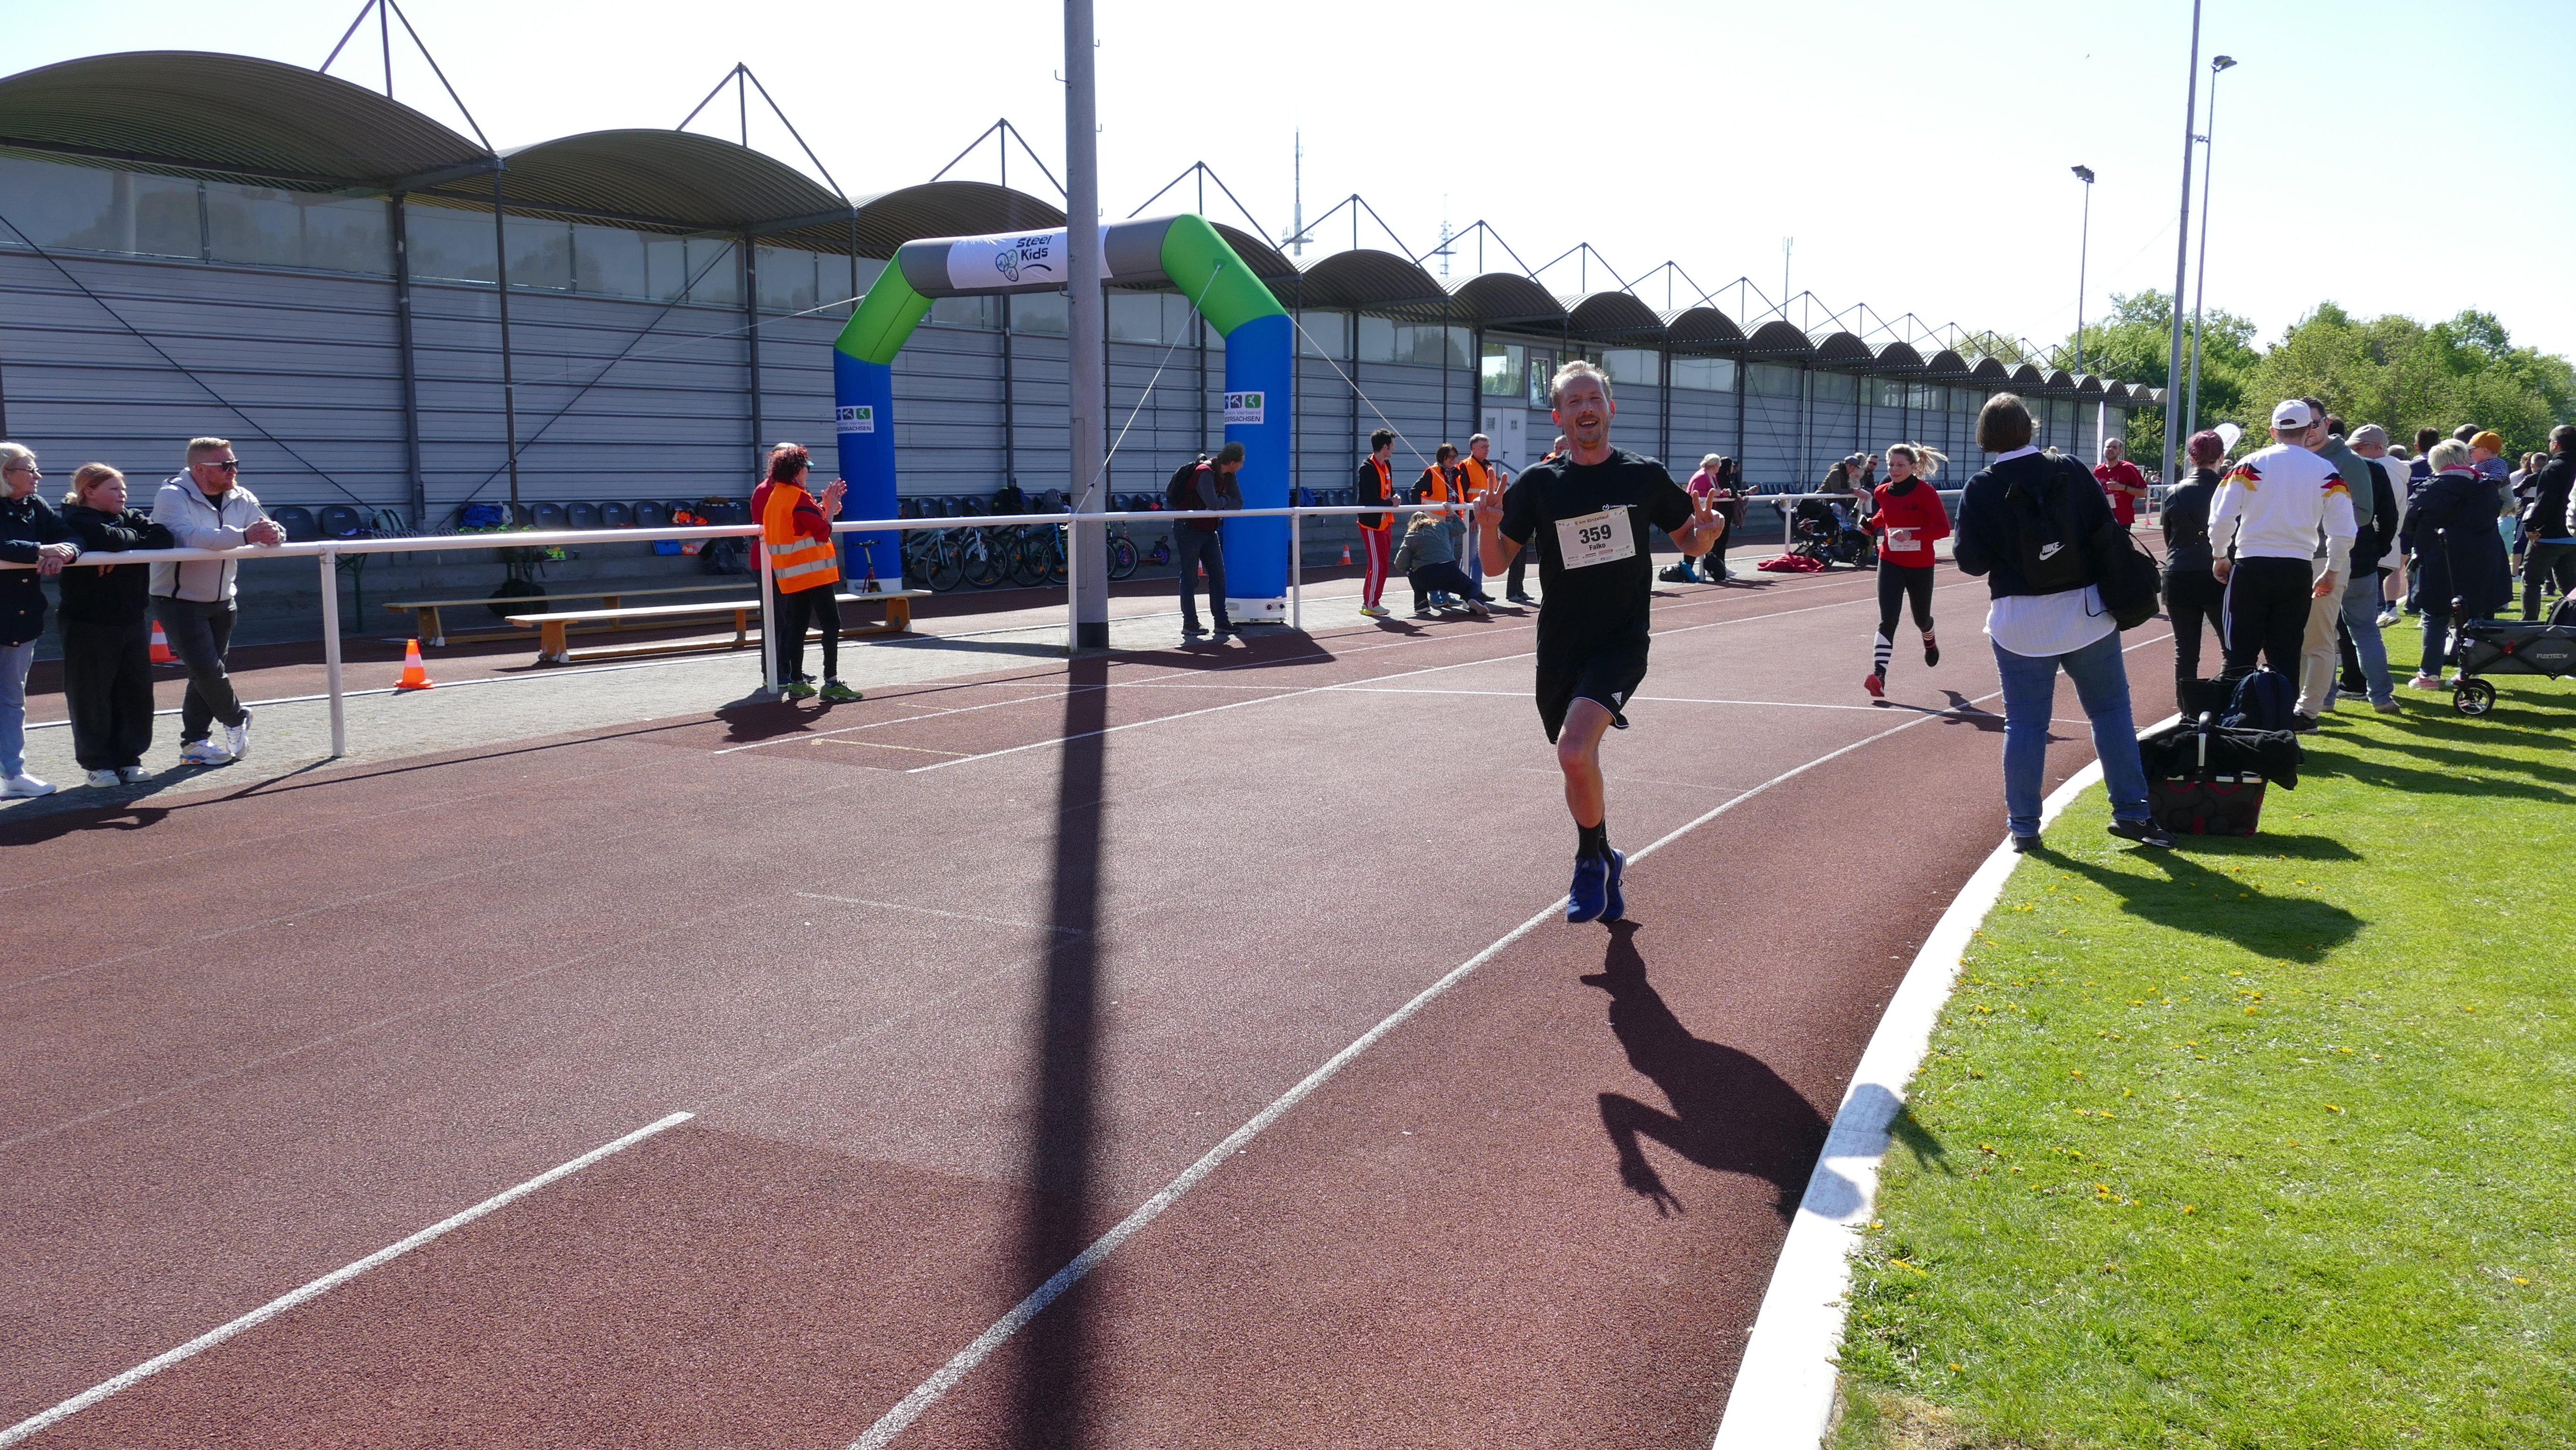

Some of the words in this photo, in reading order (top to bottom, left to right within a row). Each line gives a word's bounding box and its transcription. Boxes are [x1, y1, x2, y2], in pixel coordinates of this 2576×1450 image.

[1016, 235, 1053, 248] Steel
[1021, 248, 1048, 260] Kids
[1587, 515, 1609, 523] Einzellauf
[1578, 524, 1612, 544] 359
[2042, 541, 2059, 554] NIKE
